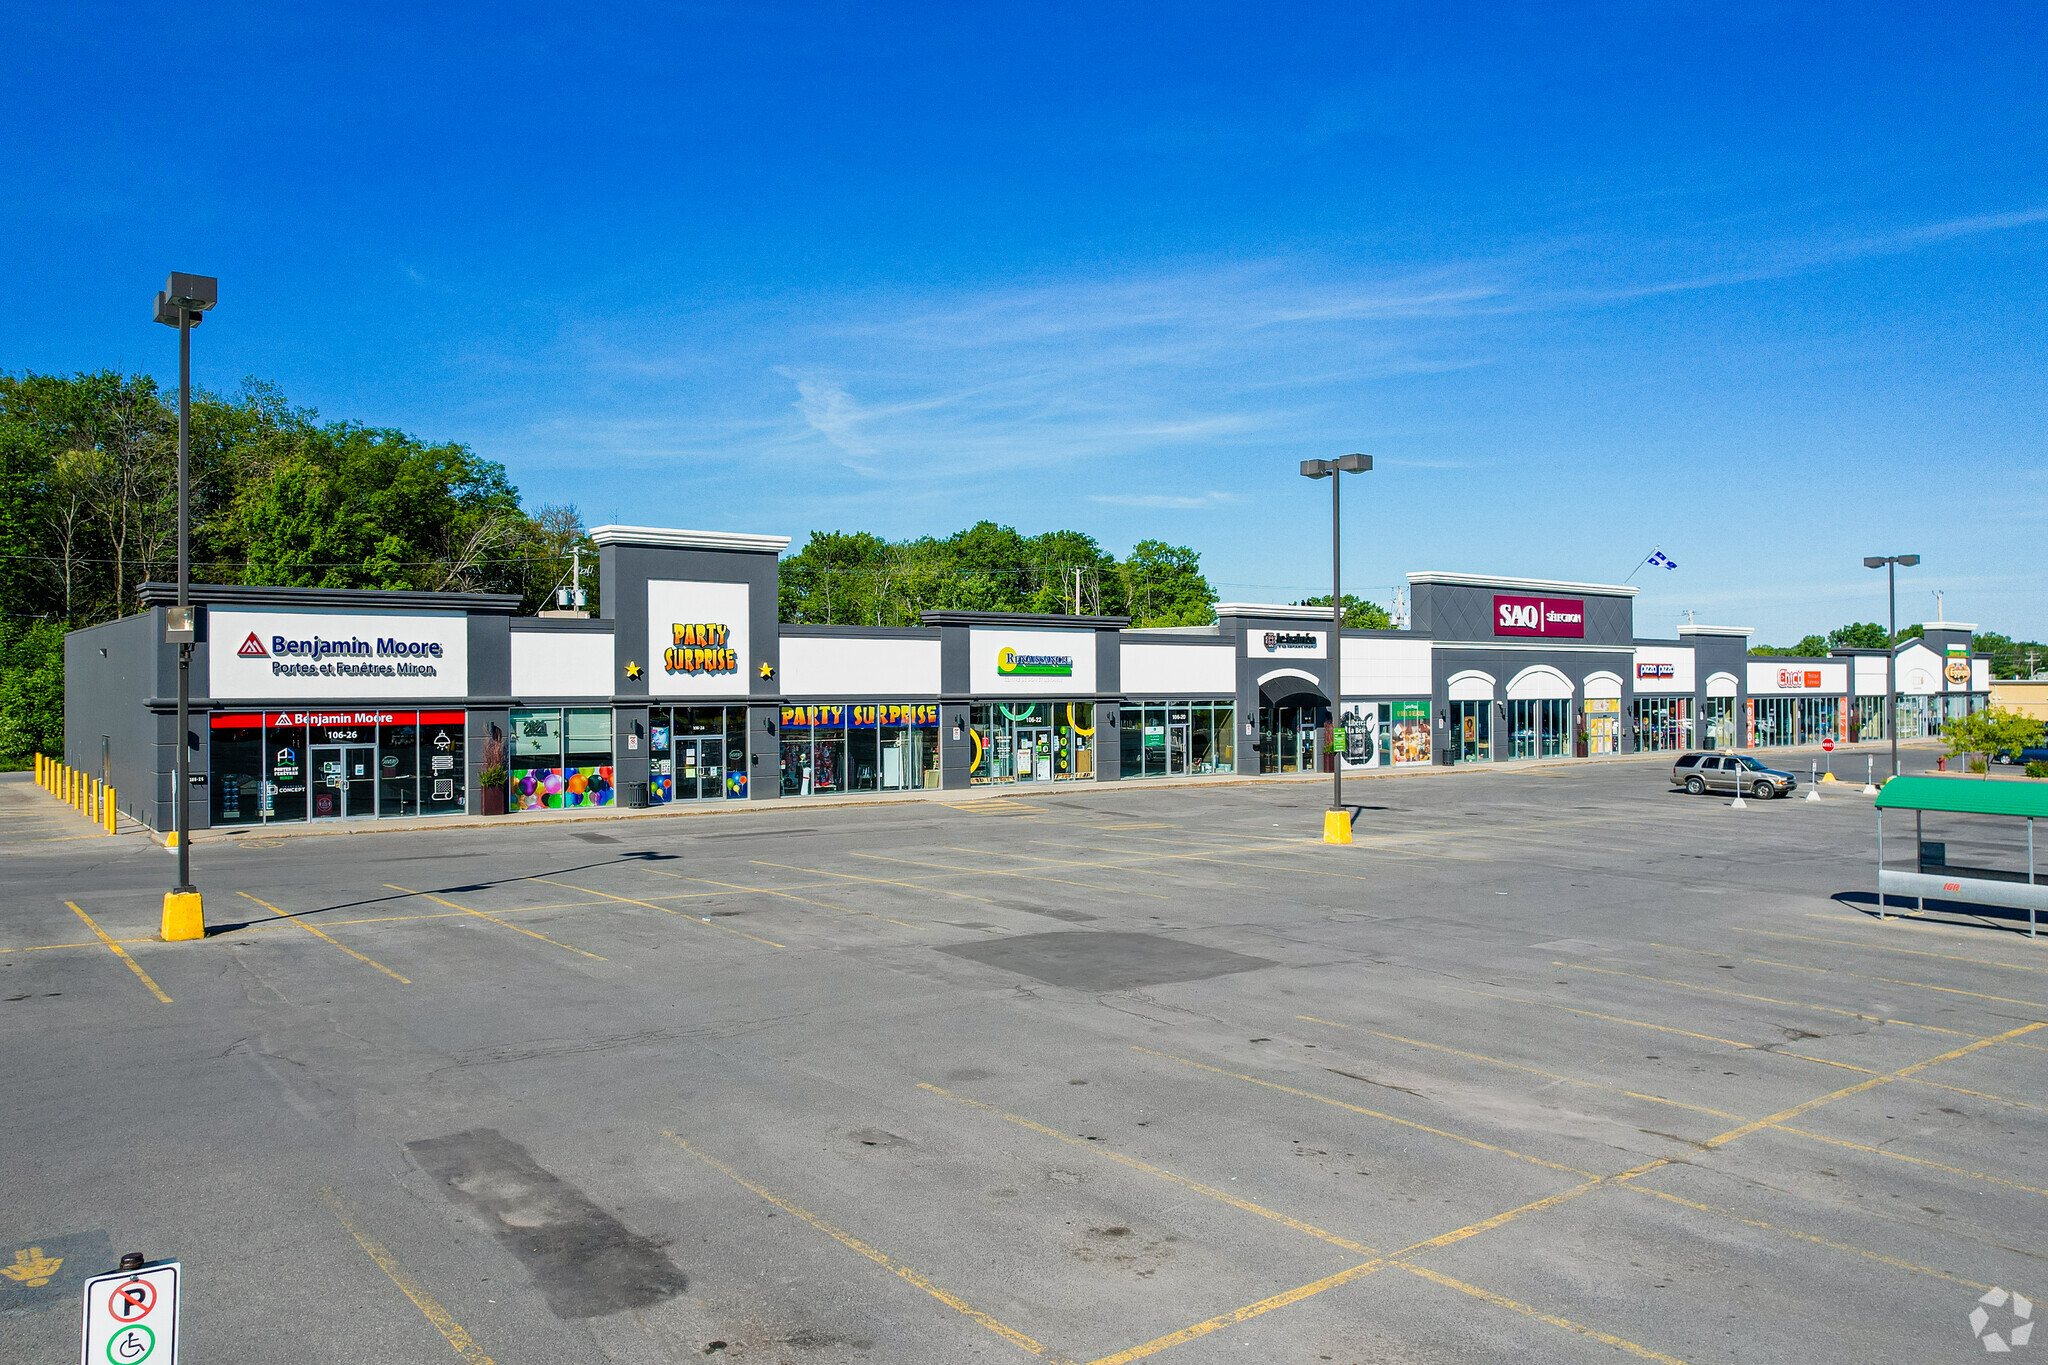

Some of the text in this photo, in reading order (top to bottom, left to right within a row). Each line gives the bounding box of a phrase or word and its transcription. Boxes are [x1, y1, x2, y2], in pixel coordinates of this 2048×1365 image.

[1499, 604, 1538, 629] SAQ
[672, 623, 728, 647] PARTY
[271, 636, 441, 659] Benjamin Moore
[272, 661, 434, 675] Portes et Fenêtres Miron
[664, 647, 736, 672] SURPRISE
[294, 713, 393, 726] Benjamin Moore
[781, 704, 937, 726] PARTY SURPRISE
[327, 731, 358, 739] 106-26
